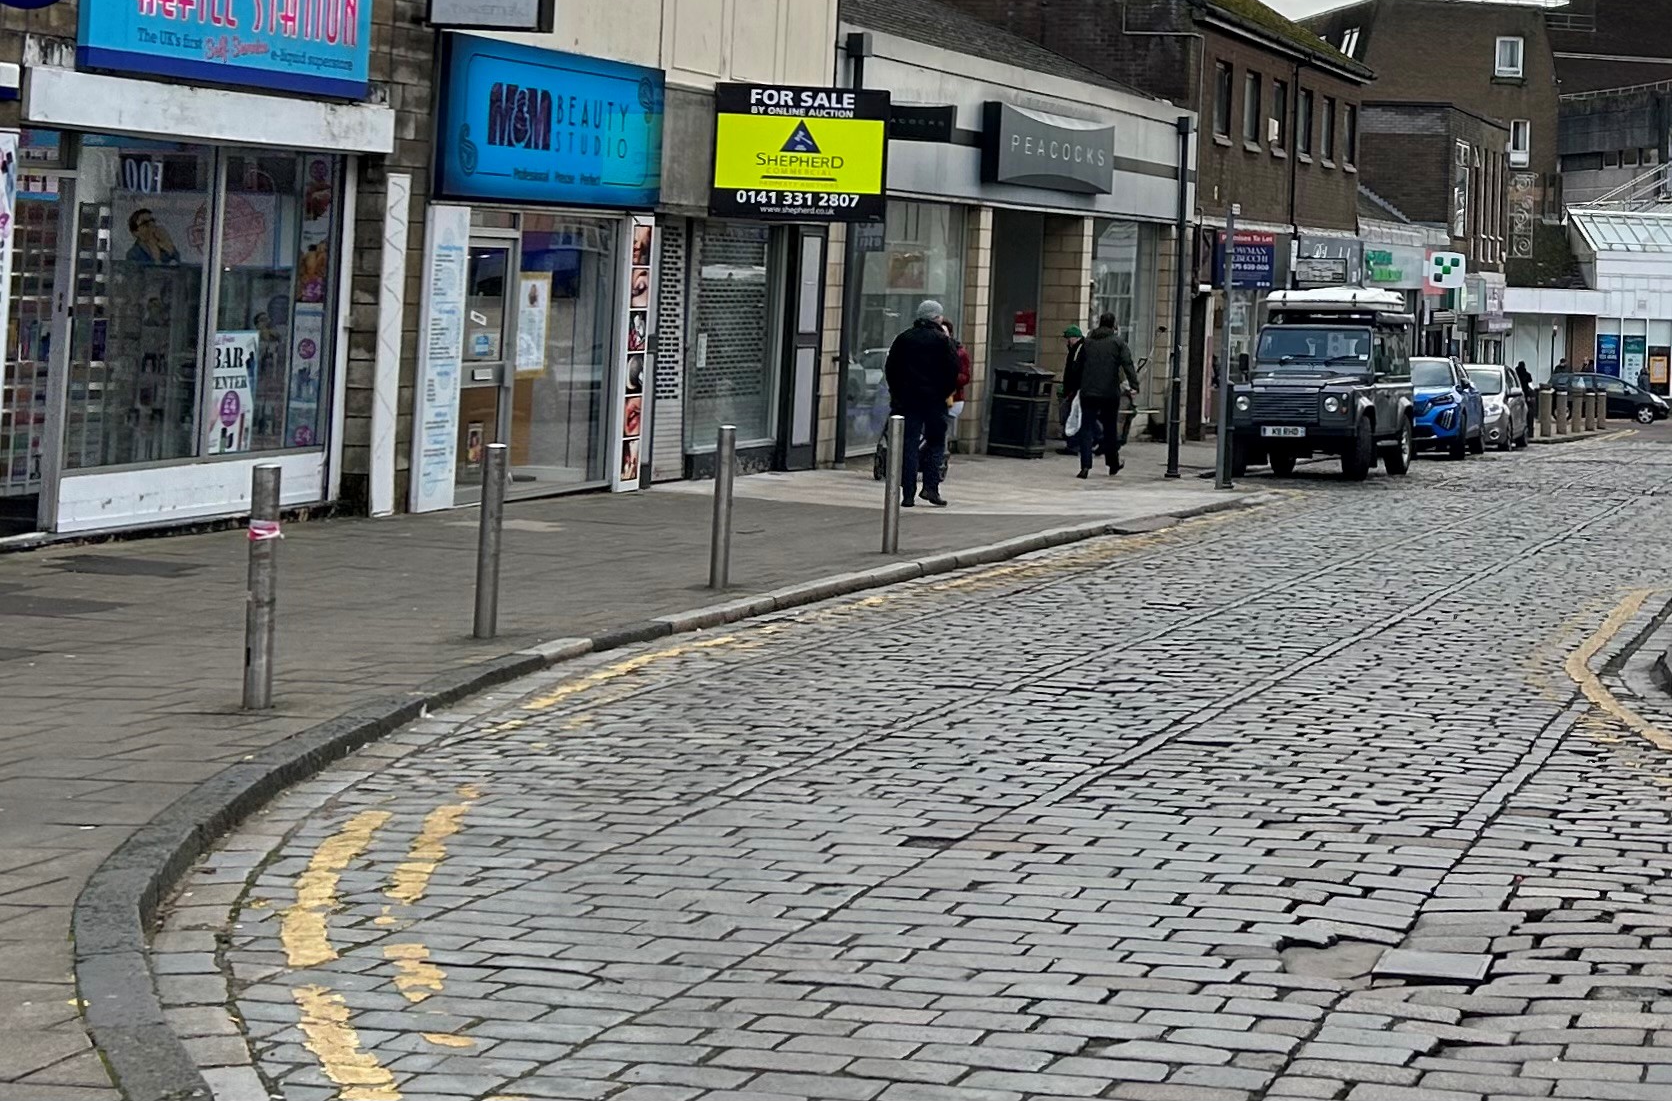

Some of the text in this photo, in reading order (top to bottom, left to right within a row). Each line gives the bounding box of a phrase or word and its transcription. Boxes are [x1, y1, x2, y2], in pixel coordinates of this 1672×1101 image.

[137, 28, 158, 43] The
[159, 29, 181, 47] UK's
[751, 89, 856, 109] FOR SALE
[556, 94, 629, 132] BEAUTY
[751, 106, 854, 118] BY ONLINE AUCTION
[890, 117, 946, 128] ACOCKS
[555, 131, 628, 159] STUDIO
[1010, 134, 1105, 167] PEACOCKS
[756, 152, 844, 169] SHEPHERD
[736, 190, 860, 208] 0141 331 2807
[760, 205, 835, 216] www.shepherd.co.uk
[1232, 246, 1267, 255] OWMAN
[214, 346, 244, 369] BAR
[212, 375, 248, 390] ENTER
